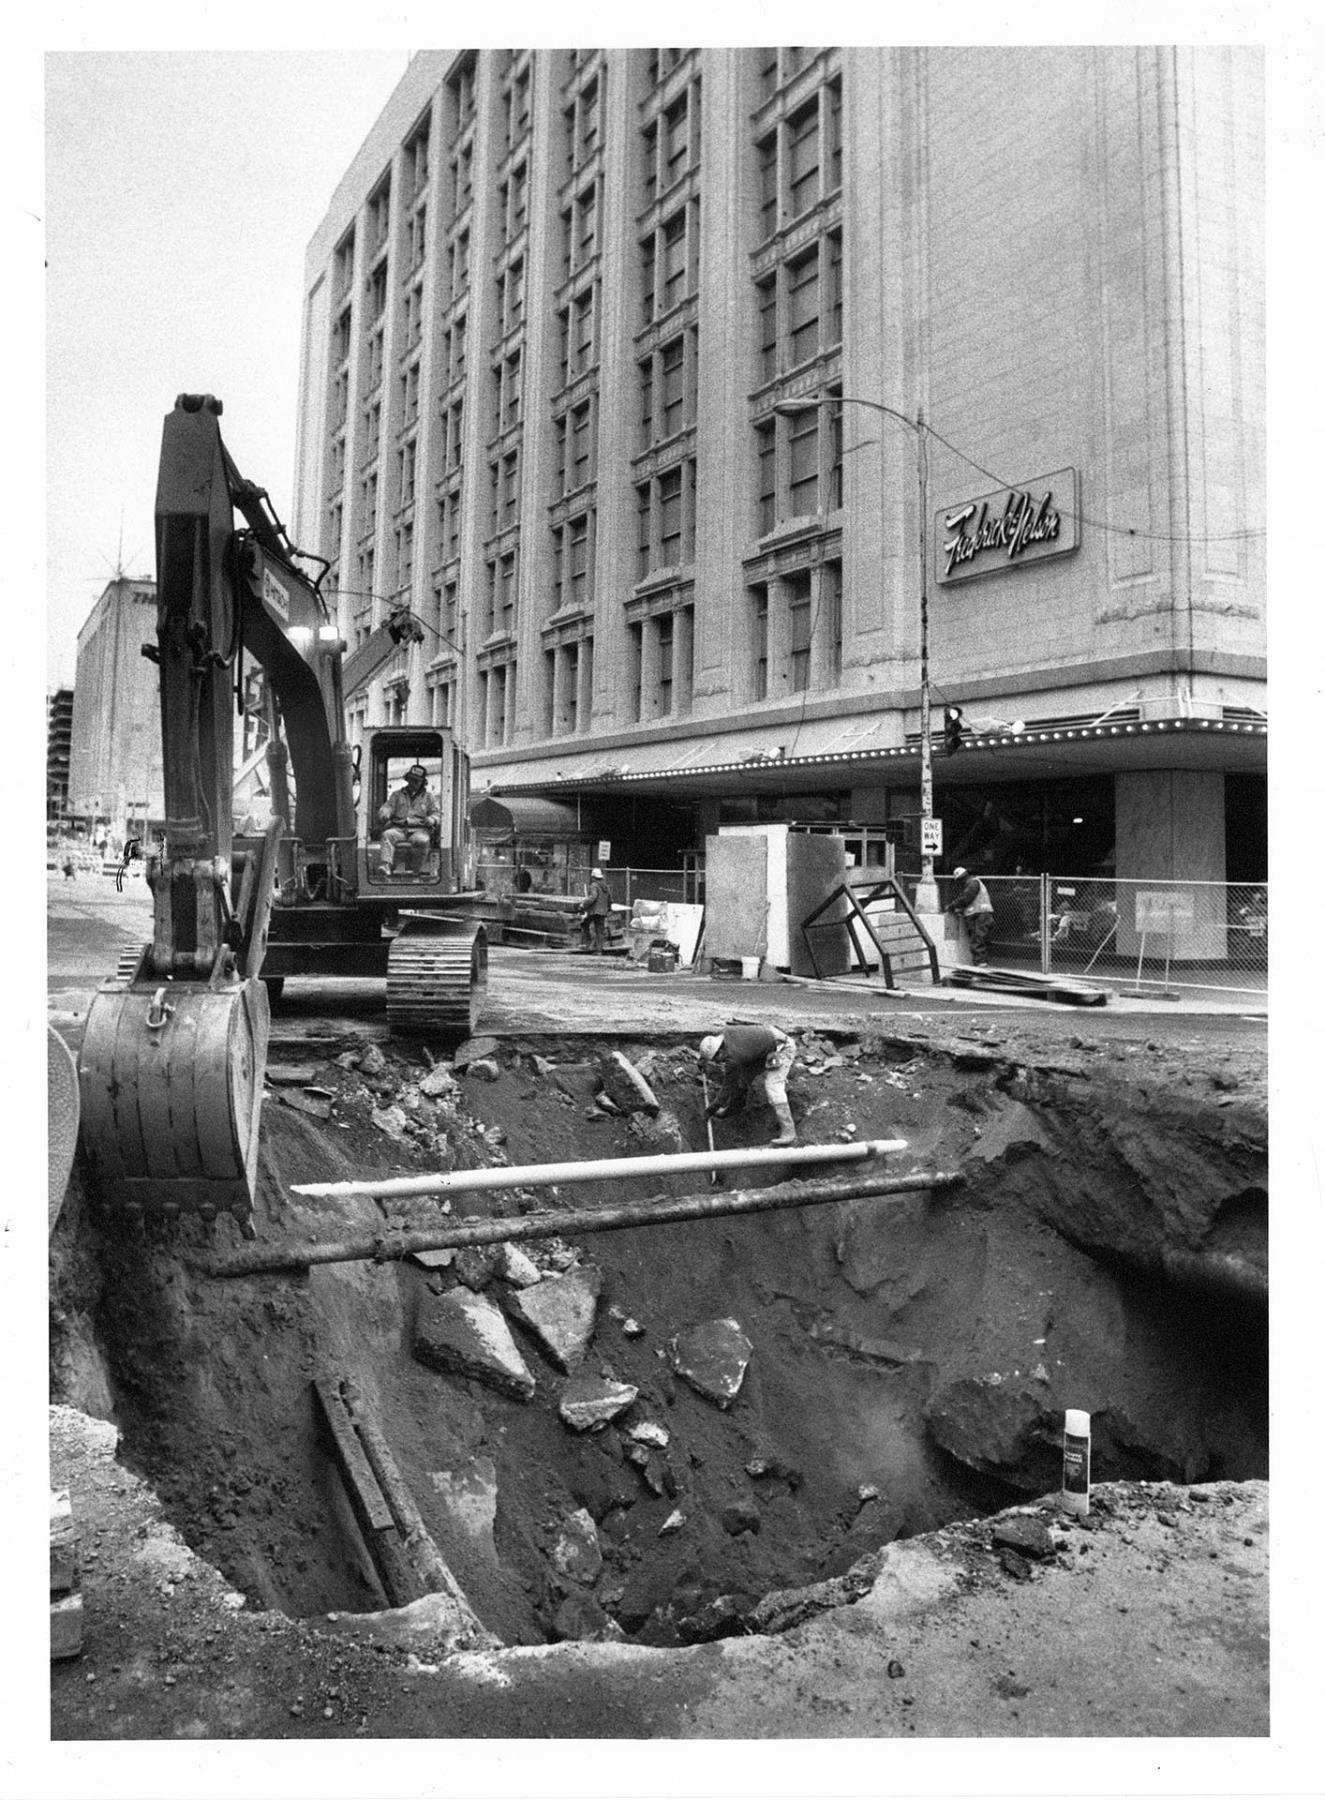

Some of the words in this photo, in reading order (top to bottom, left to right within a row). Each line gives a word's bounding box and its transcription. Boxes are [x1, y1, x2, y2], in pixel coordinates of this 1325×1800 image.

[944, 492, 1014, 575] Frederick
[1008, 491, 1061, 559] Nelson
[924, 822, 940, 831] ONE
[924, 832, 940, 840] WAY
